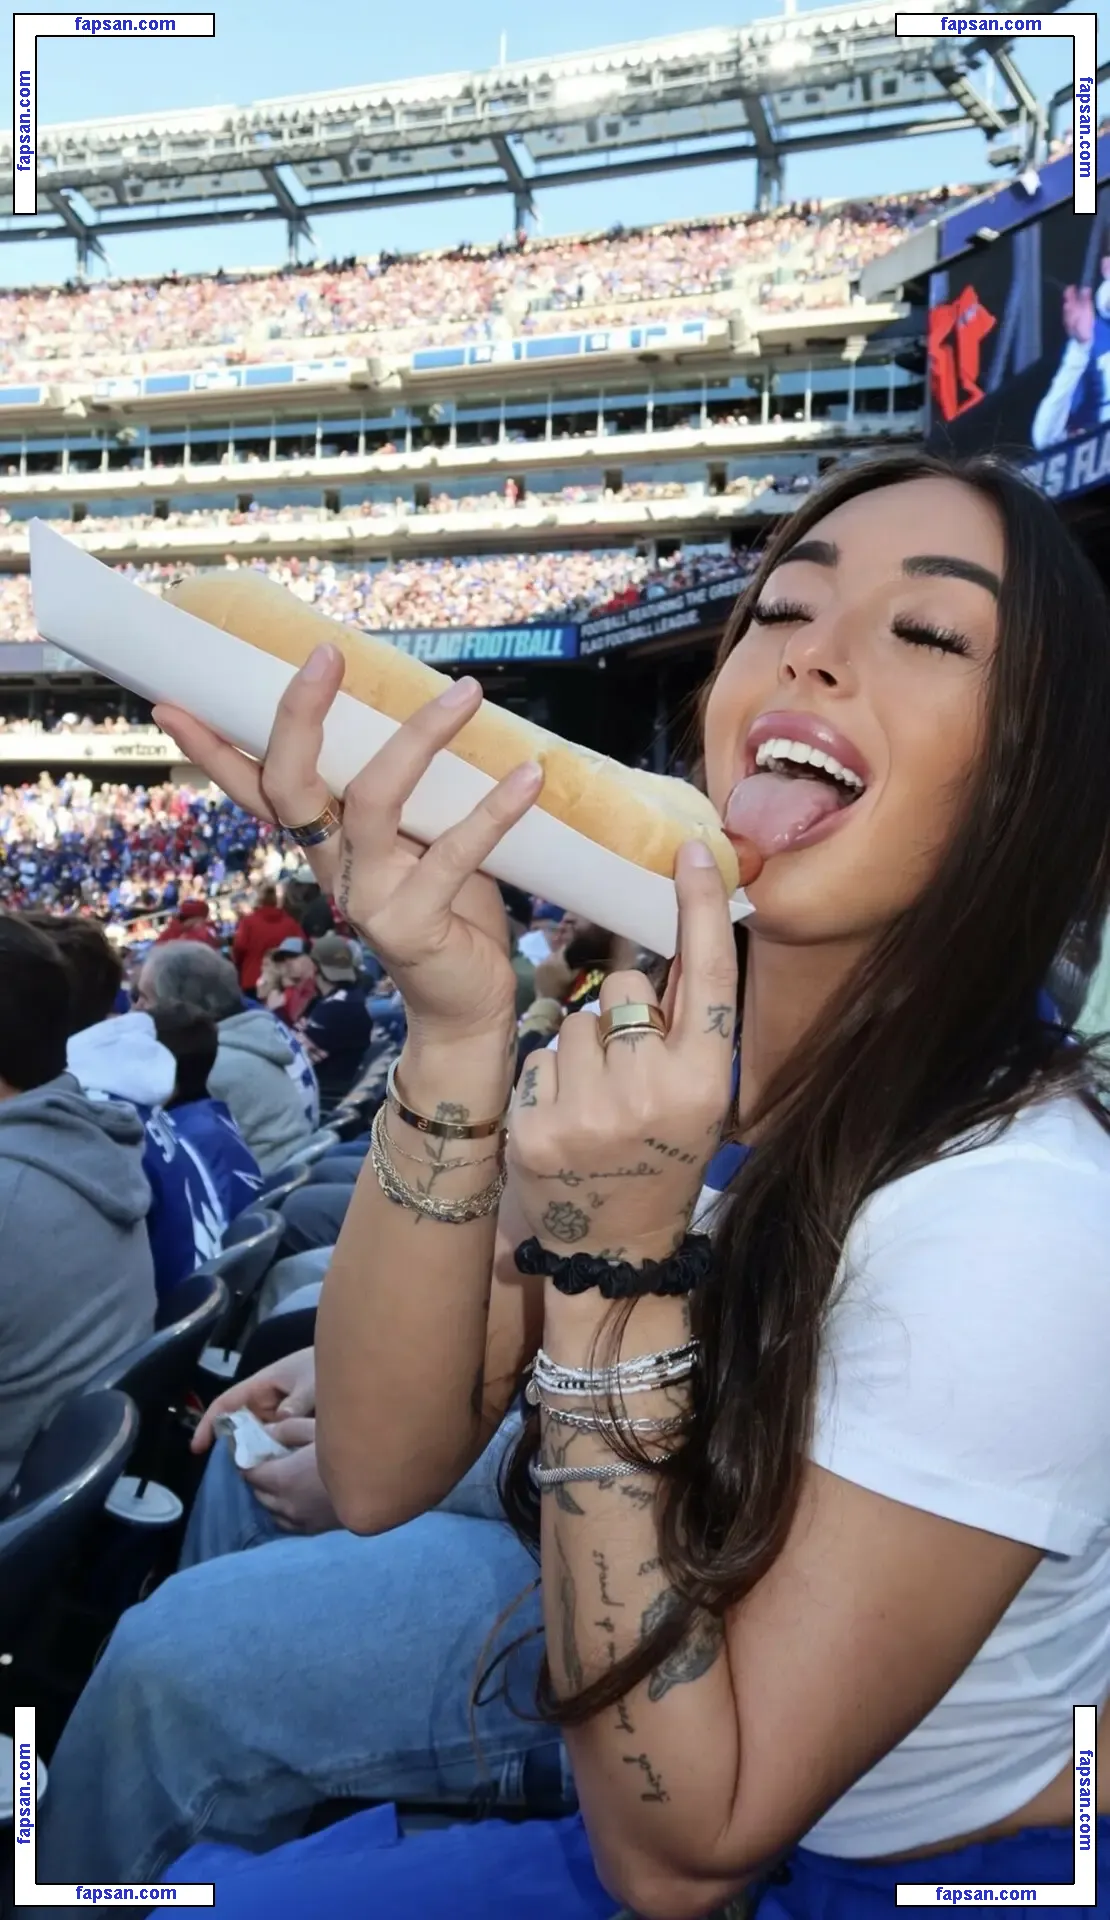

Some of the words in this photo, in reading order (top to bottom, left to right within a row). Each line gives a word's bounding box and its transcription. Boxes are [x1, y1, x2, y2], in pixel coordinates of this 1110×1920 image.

[686, 587, 708, 606] THE
[413, 632, 463, 661] FLAG
[464, 628, 564, 659] FOOTBALL
[113, 743, 167, 756] verizon
